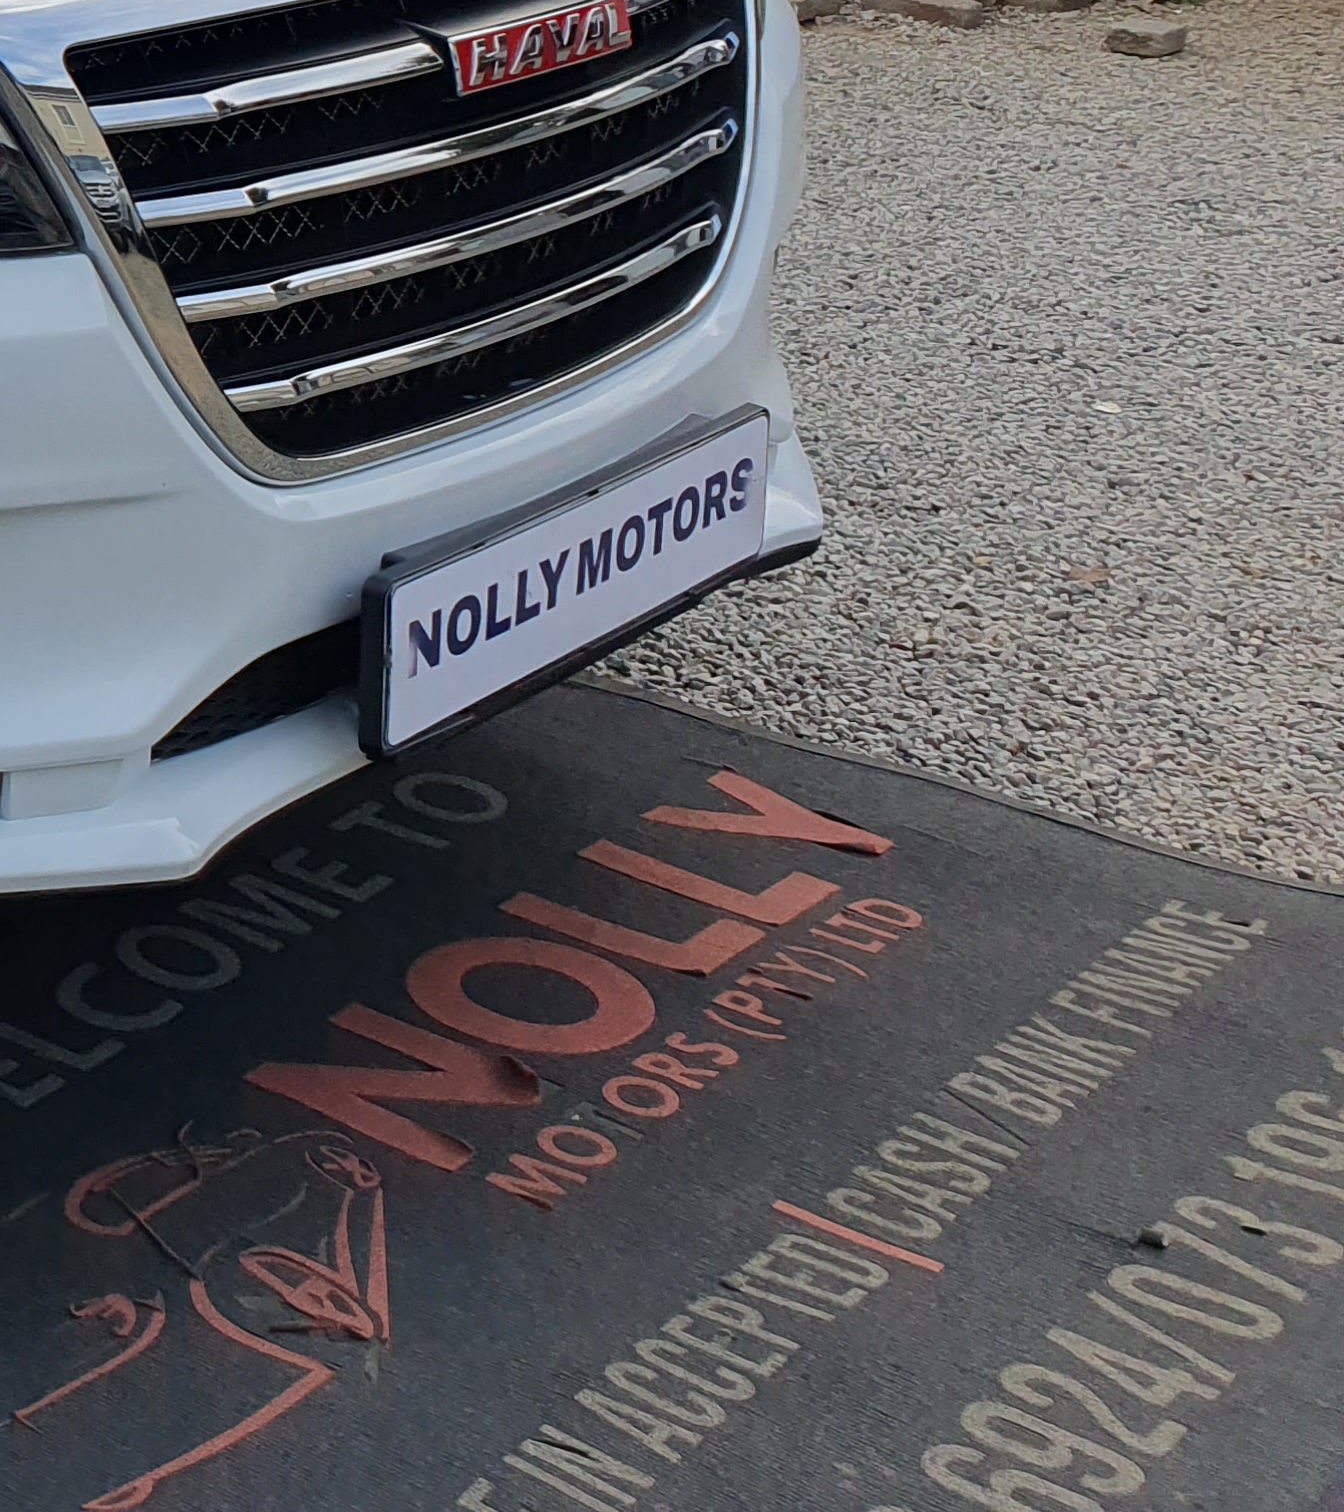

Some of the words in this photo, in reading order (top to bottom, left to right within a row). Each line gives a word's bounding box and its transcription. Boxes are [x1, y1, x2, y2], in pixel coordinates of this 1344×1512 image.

[469, 2, 632, 87] HAVAL
[407, 548, 571, 680] NOLLY
[575, 457, 754, 596] MOTORS
[330, 771, 510, 850] TO
[242, 769, 895, 1172] NOLLY
[484, 1031, 740, 1211] MOTORS
[703, 944, 869, 1041] (PTY)
[808, 897, 925, 955] LTD
[573, 1232, 890, 1464] ACCEPTED
[1048, 899, 1269, 1037] FINANCE
